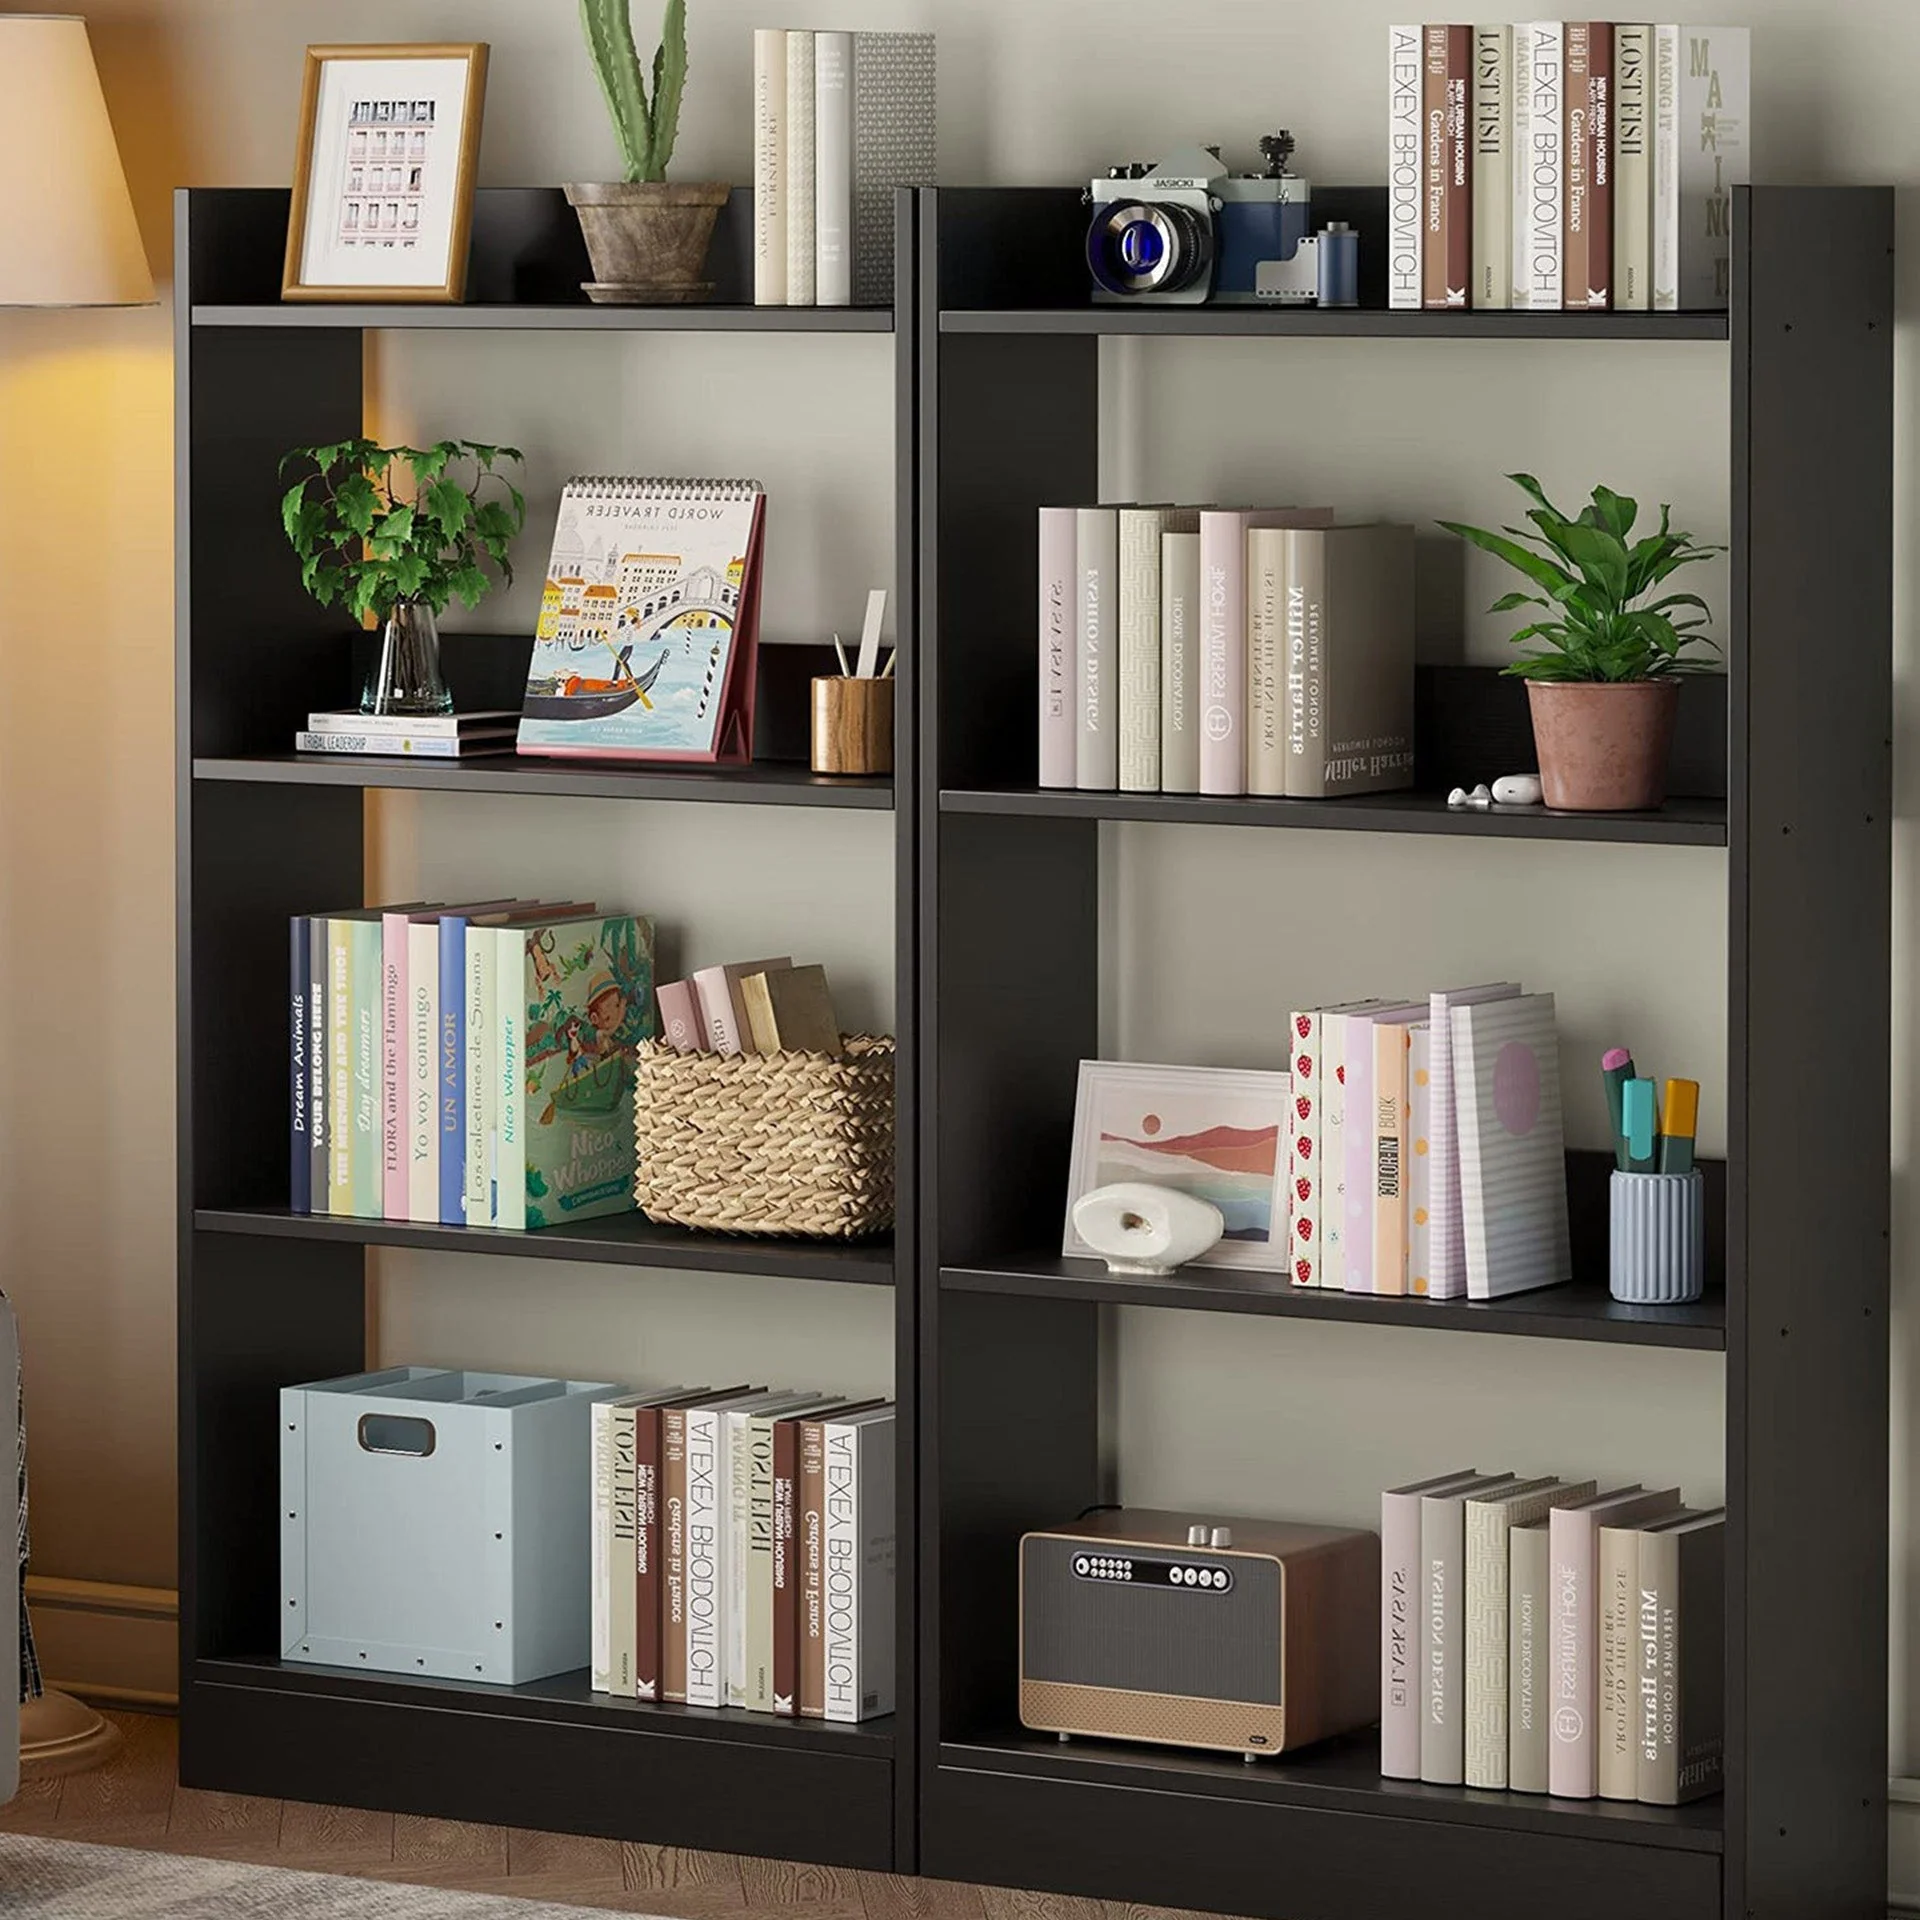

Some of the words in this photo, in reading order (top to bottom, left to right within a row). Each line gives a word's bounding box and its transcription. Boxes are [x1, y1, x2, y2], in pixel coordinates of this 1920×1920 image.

[1393, 32, 1416, 126] ALEXEY
[1478, 33, 1500, 95] LOST
[1516, 36, 1529, 108] MAKING
[1533, 31, 1557, 125] ALEXEY
[1621, 33, 1643, 95] LOST
[1659, 38, 1672, 108] MAKING
[1455, 79, 1464, 102] NEW
[1597, 77, 1606, 101] NEW
[1430, 109, 1443, 165] Gardens
[1455, 104, 1464, 138] URBAN
[1478, 102, 1500, 154] FISH
[1570, 108, 1584, 165] Gardens
[1597, 102, 1606, 137] URBAN
[1621, 103, 1643, 154] FISH
[1659, 113, 1672, 130] IT
[769, 112, 777, 216] FURNITURE
[1430, 169, 1443, 182] in
[1455, 141, 1464, 185] HOUSING
[1571, 169, 1584, 182] in
[1597, 139, 1606, 185] HOUSING
[1393, 135, 1416, 290] BRODOVITCH
[1430, 186, 1443, 232] France
[1533, 133, 1557, 290] BRODOVITCH
[1571, 185, 1584, 232] France
[303, 735, 326, 749] TRIBAL
[328, 735, 366, 750] LEADERSHIP
[386, 964, 398, 1044] Flamingo
[470, 952, 484, 1029] Susana
[292, 994, 304, 1066] Animals
[416, 986, 430, 1080] conmigo
[444, 1012, 456, 1088] AMOR
[470, 1035, 482, 1058] de
[386, 1049, 396, 1076] the
[504, 1016, 514, 1097] Whopper
[294, 1072, 305, 1131] Dream
[387, 1082, 396, 1113] and
[418, 1091, 430, 1124] voy
[446, 1098, 456, 1132] UN
[470, 1064, 482, 1158] calcetines
[1379, 1096, 1395, 1128] BOOK
[313, 1100, 323, 1147] YOUR
[387, 1118, 397, 1171] FLORA
[415, 1134, 428, 1160] Yo
[504, 1106, 514, 1143] Nico
[571, 1130, 613, 1159] Nico
[470, 1163, 485, 1203] Los
